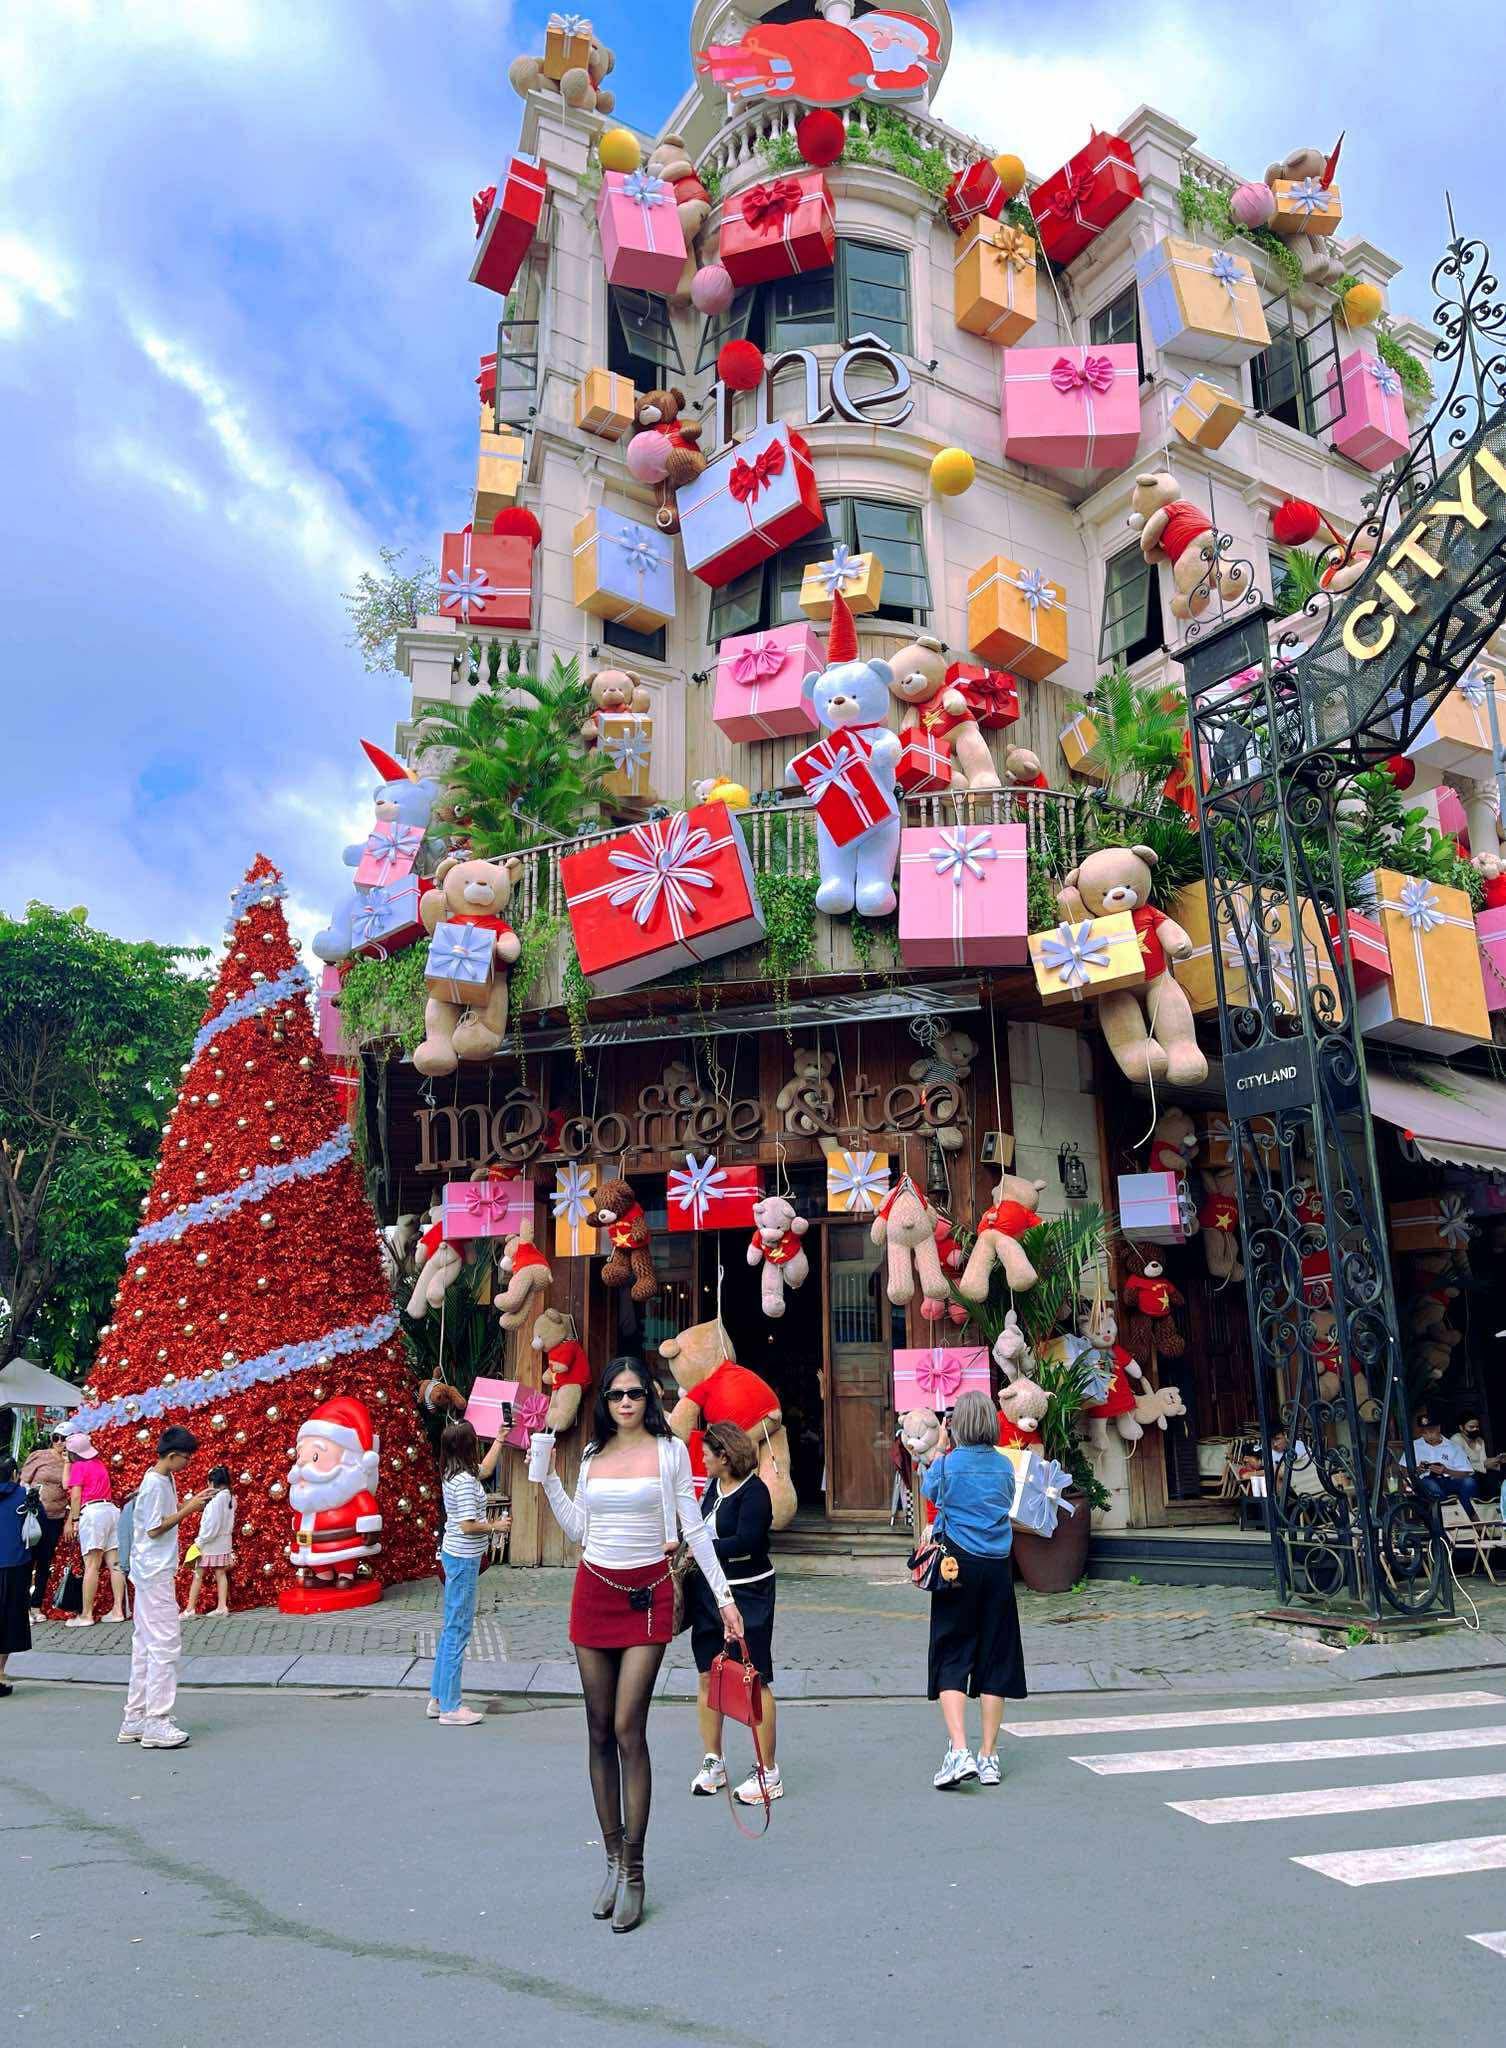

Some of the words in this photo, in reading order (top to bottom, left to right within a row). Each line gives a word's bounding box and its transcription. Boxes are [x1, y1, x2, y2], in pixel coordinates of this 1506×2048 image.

[1236, 1066, 1297, 1091] CITYLAND
[414, 1087, 548, 1172] mê
[559, 1083, 764, 1157] coffee
[791, 1084, 847, 1137] &
[849, 1073, 969, 1133] tea
